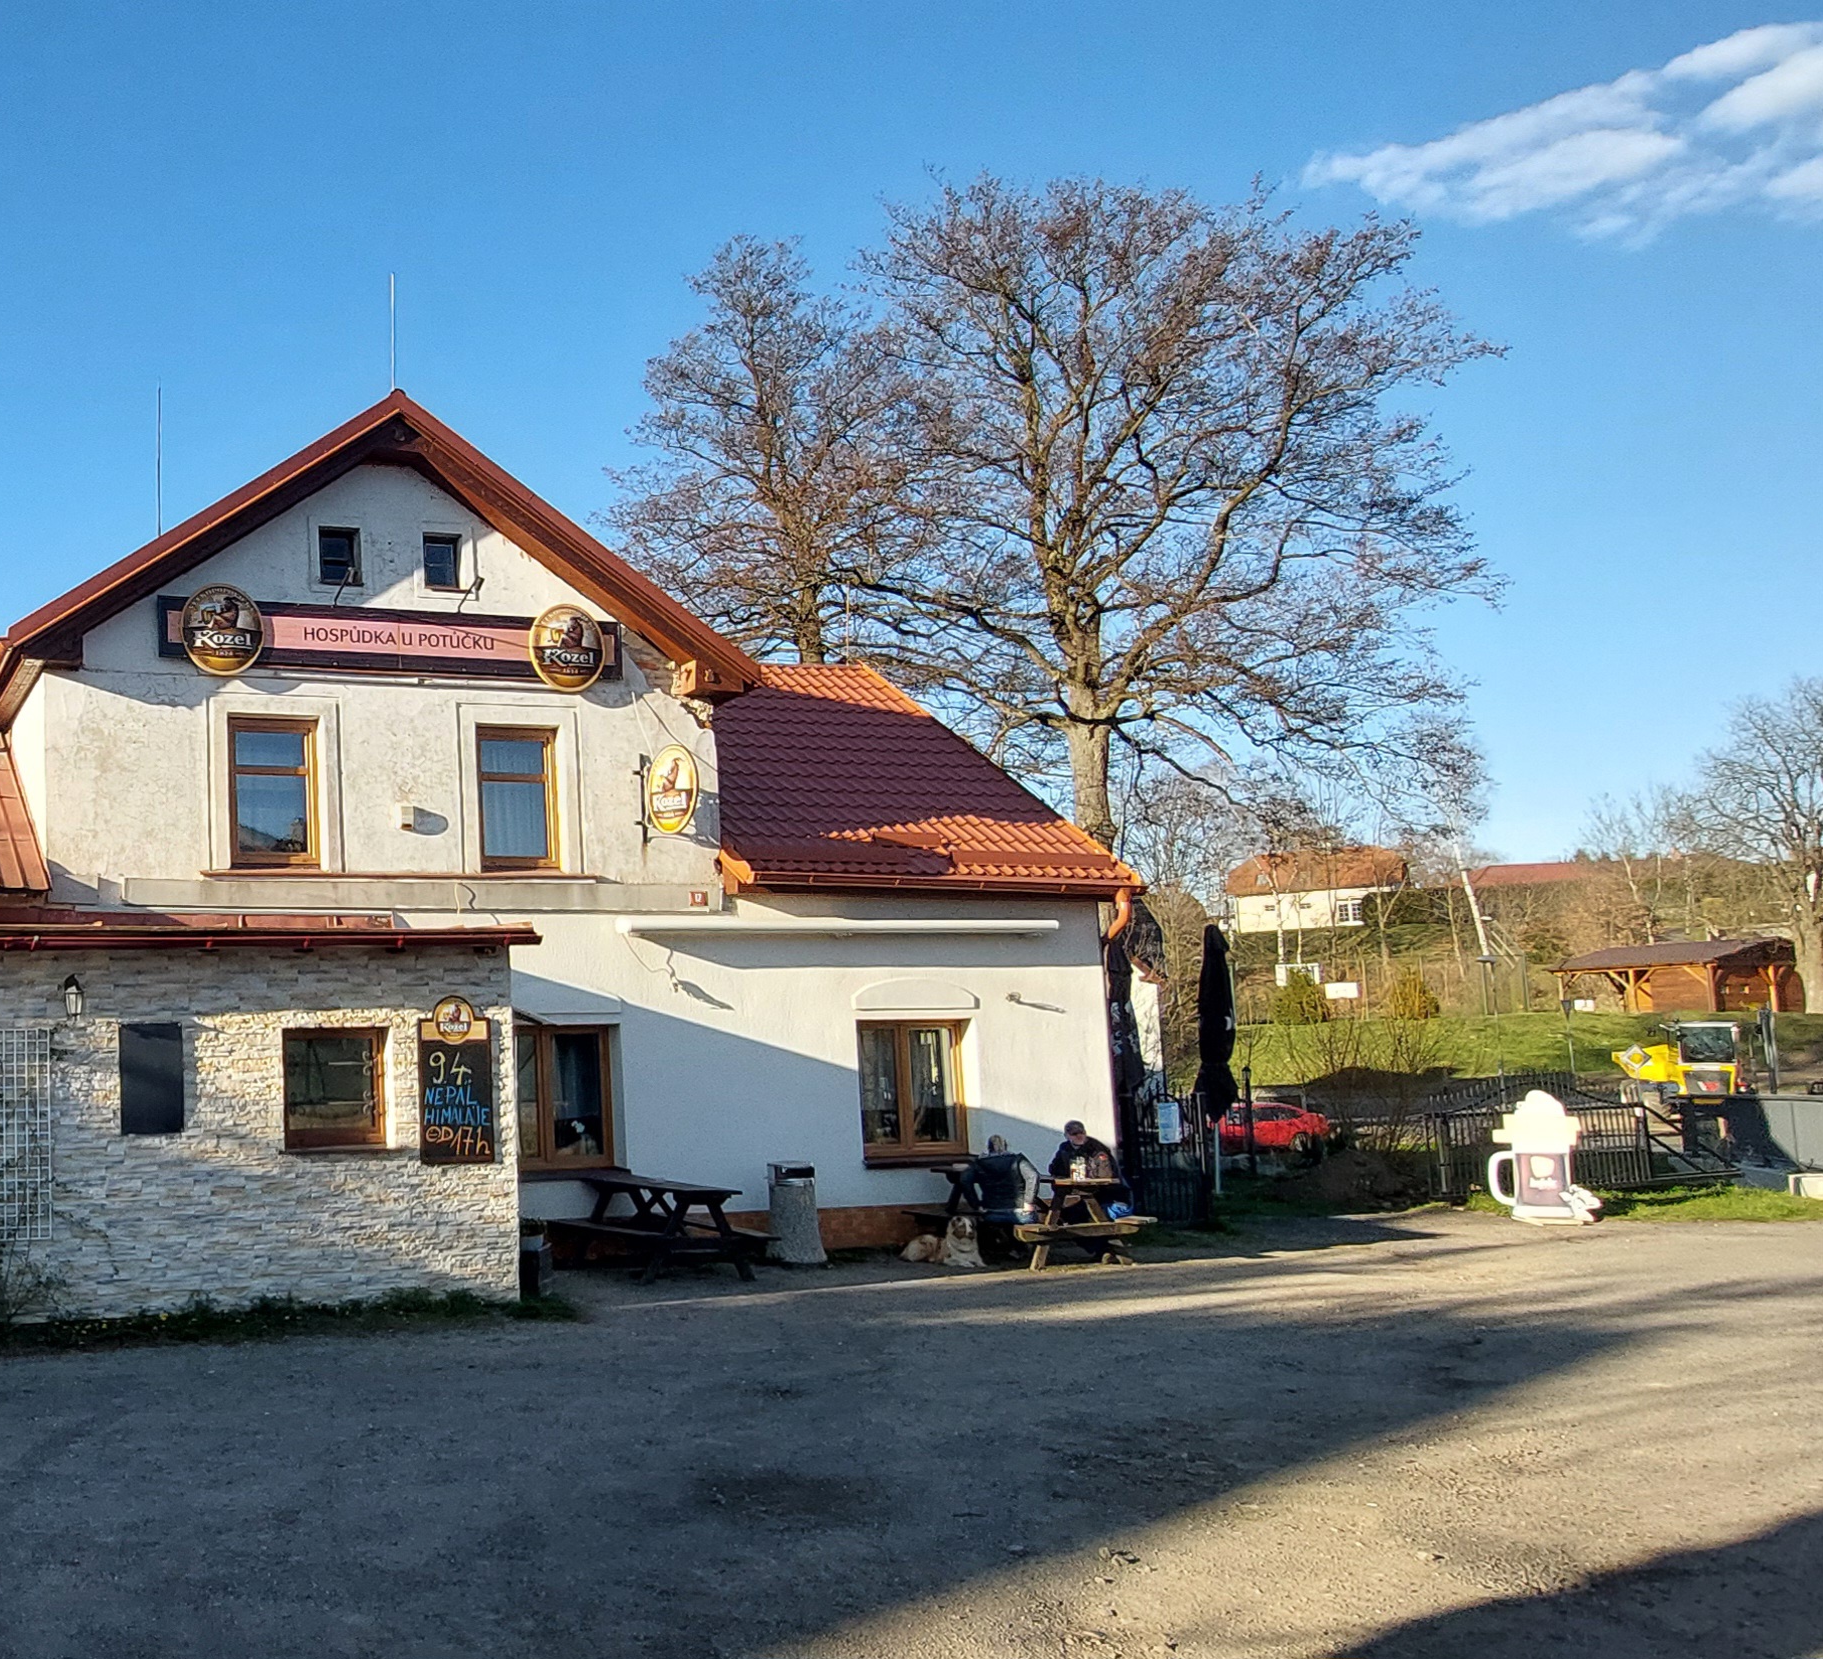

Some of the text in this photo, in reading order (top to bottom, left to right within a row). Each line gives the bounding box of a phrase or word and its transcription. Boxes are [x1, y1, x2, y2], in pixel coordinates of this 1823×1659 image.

[193, 630, 253, 649] Kozel
[303, 626, 495, 650] HOSPŮDKA U POTŮČKU
[542, 648, 594, 667] Kozel
[653, 792, 687, 811] Kozel
[440, 1023, 468, 1033] Kozel
[426, 1126, 453, 1143] OD
